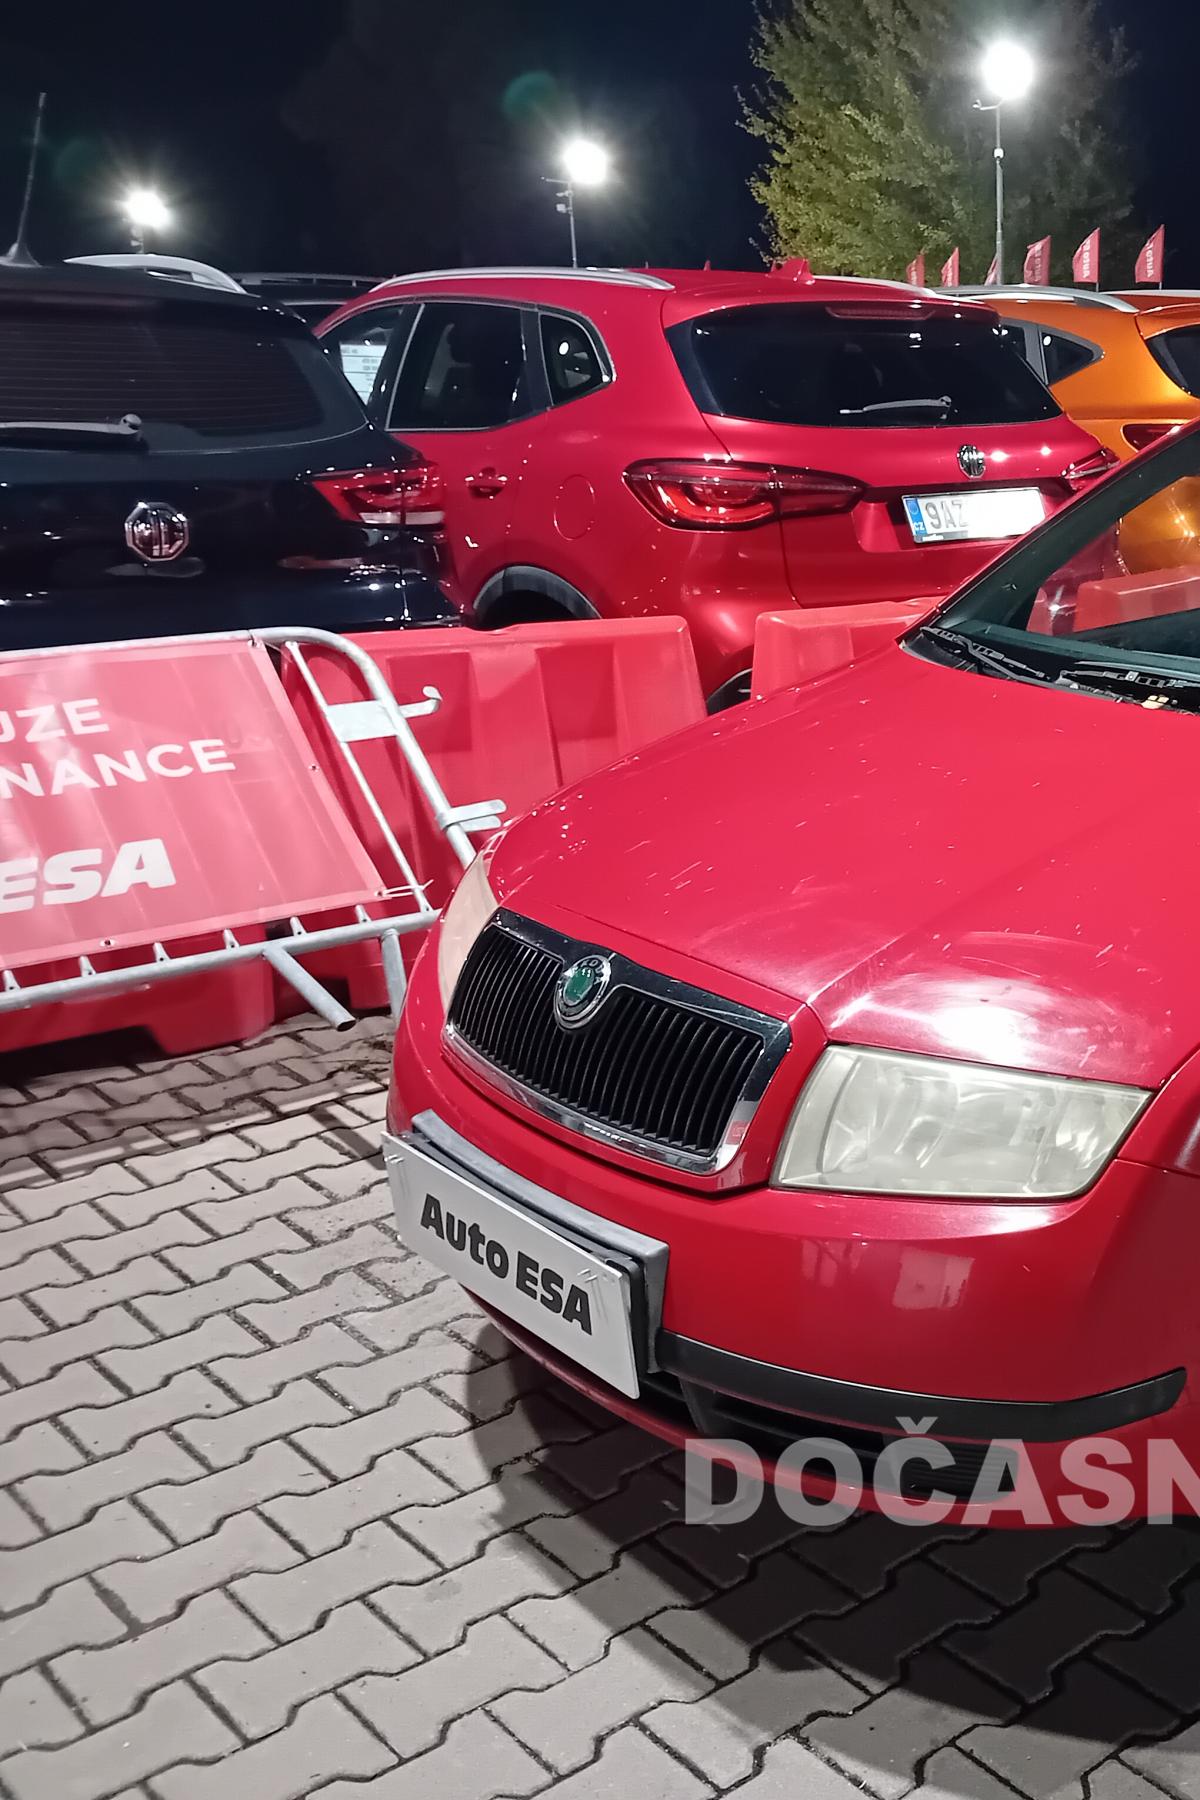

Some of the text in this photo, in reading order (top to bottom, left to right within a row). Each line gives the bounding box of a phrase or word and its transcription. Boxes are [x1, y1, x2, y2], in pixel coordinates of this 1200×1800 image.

[0, 838, 177, 914] ESA
[420, 1193, 592, 1336] Auto ESA
